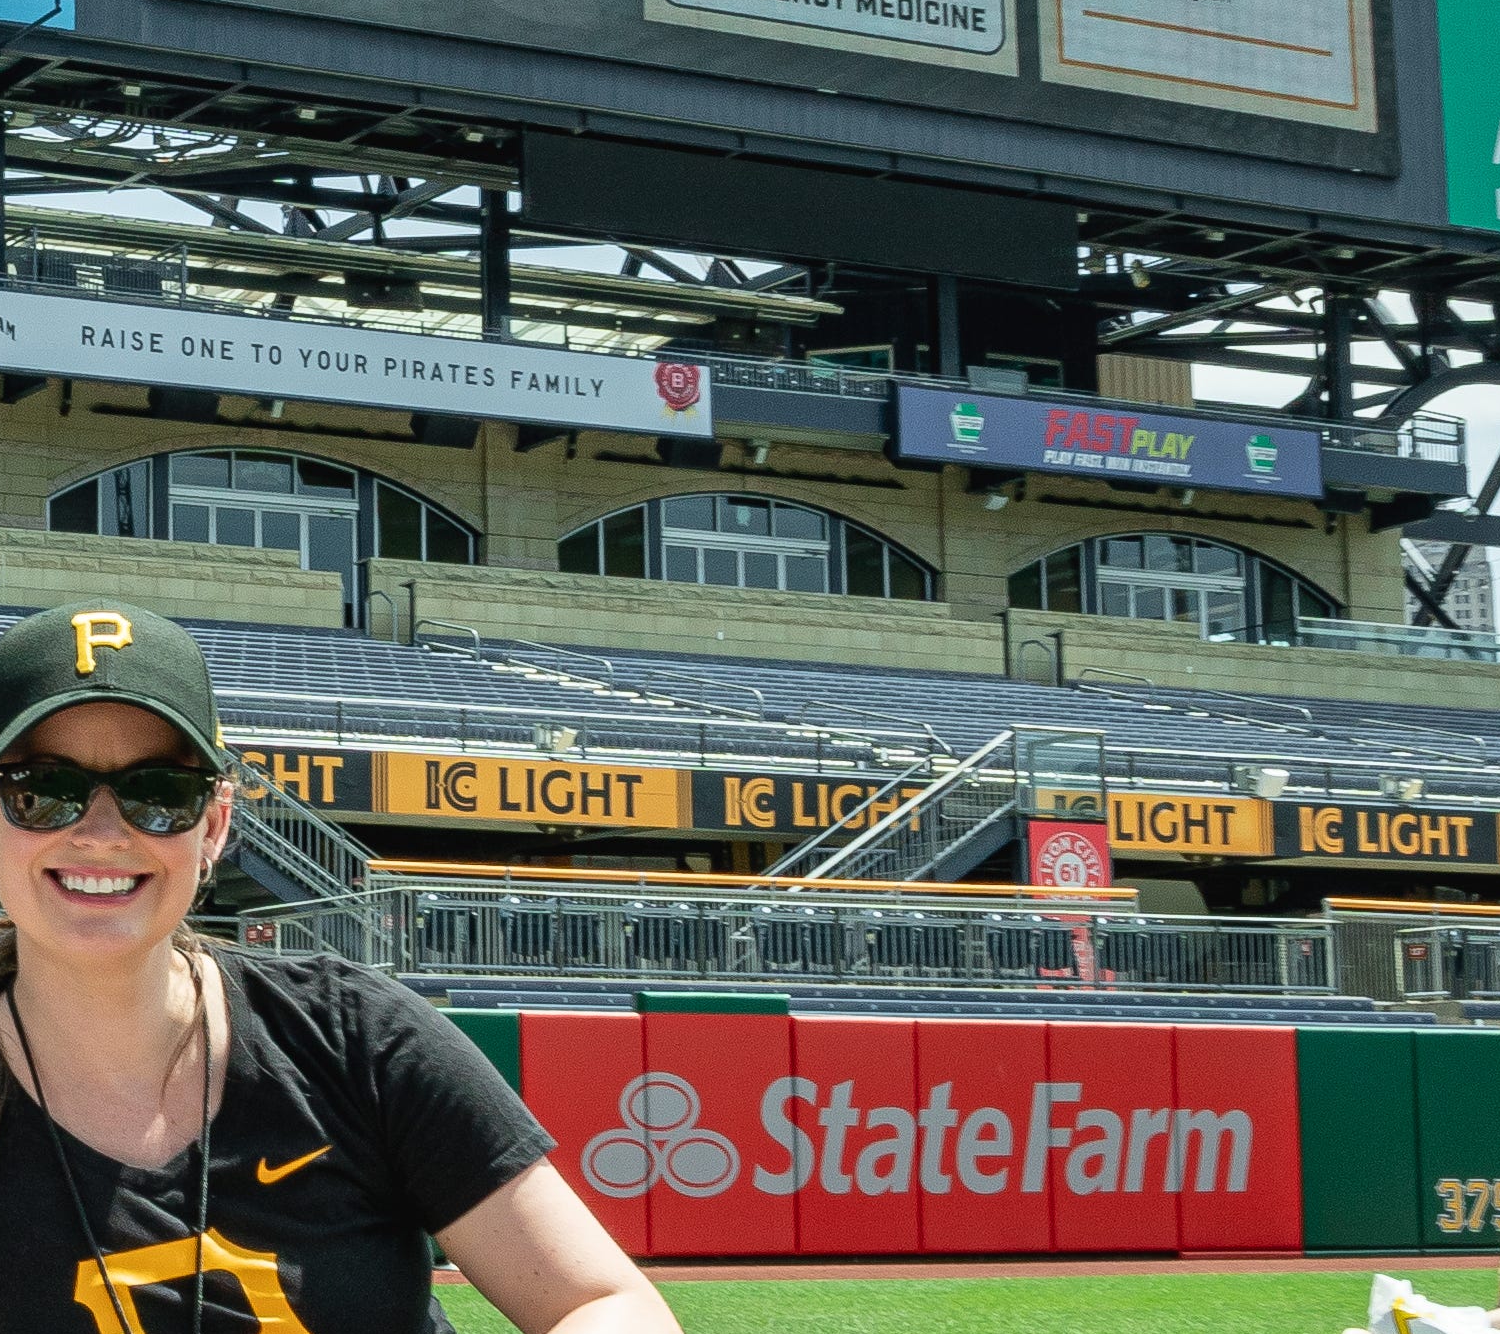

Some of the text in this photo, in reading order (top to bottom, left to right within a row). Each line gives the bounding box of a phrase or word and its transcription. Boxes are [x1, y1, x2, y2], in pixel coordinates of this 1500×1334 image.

[80, 324, 606, 400] RAISE ONE TO YOUR PIRATES FAMILY
[70, 610, 133, 675] P
[240, 751, 344, 804] GHT
[425, 759, 643, 820] IC LIGHT
[790, 782, 927, 832] LIGHT
[1113, 799, 1237, 846] LIGHT
[1356, 810, 1475, 859] LIGHT
[1059, 863, 1081, 883] 61
